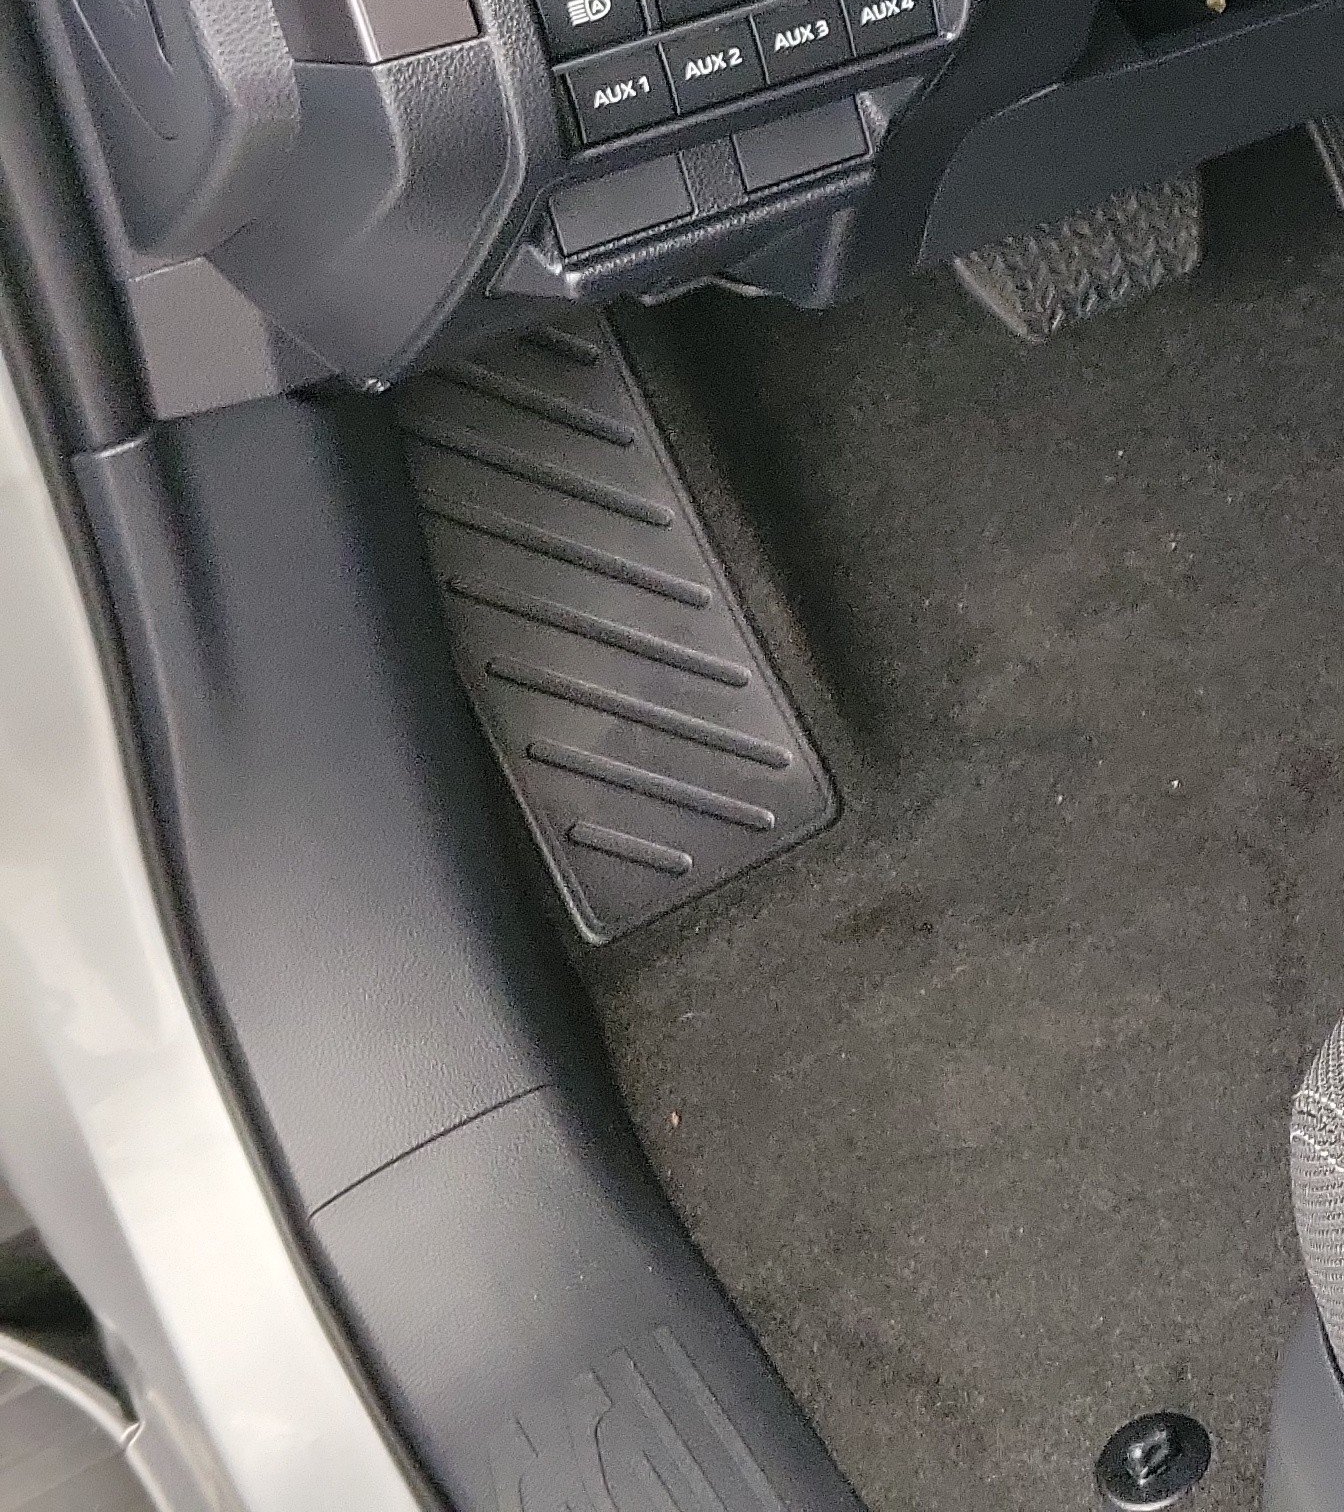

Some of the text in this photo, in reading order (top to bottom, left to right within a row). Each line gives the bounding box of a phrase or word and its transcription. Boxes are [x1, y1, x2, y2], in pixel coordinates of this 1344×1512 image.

[774, 19, 829, 53] AUX 3
[685, 47, 743, 80] AUX 2
[594, 76, 650, 108] AUX 1
